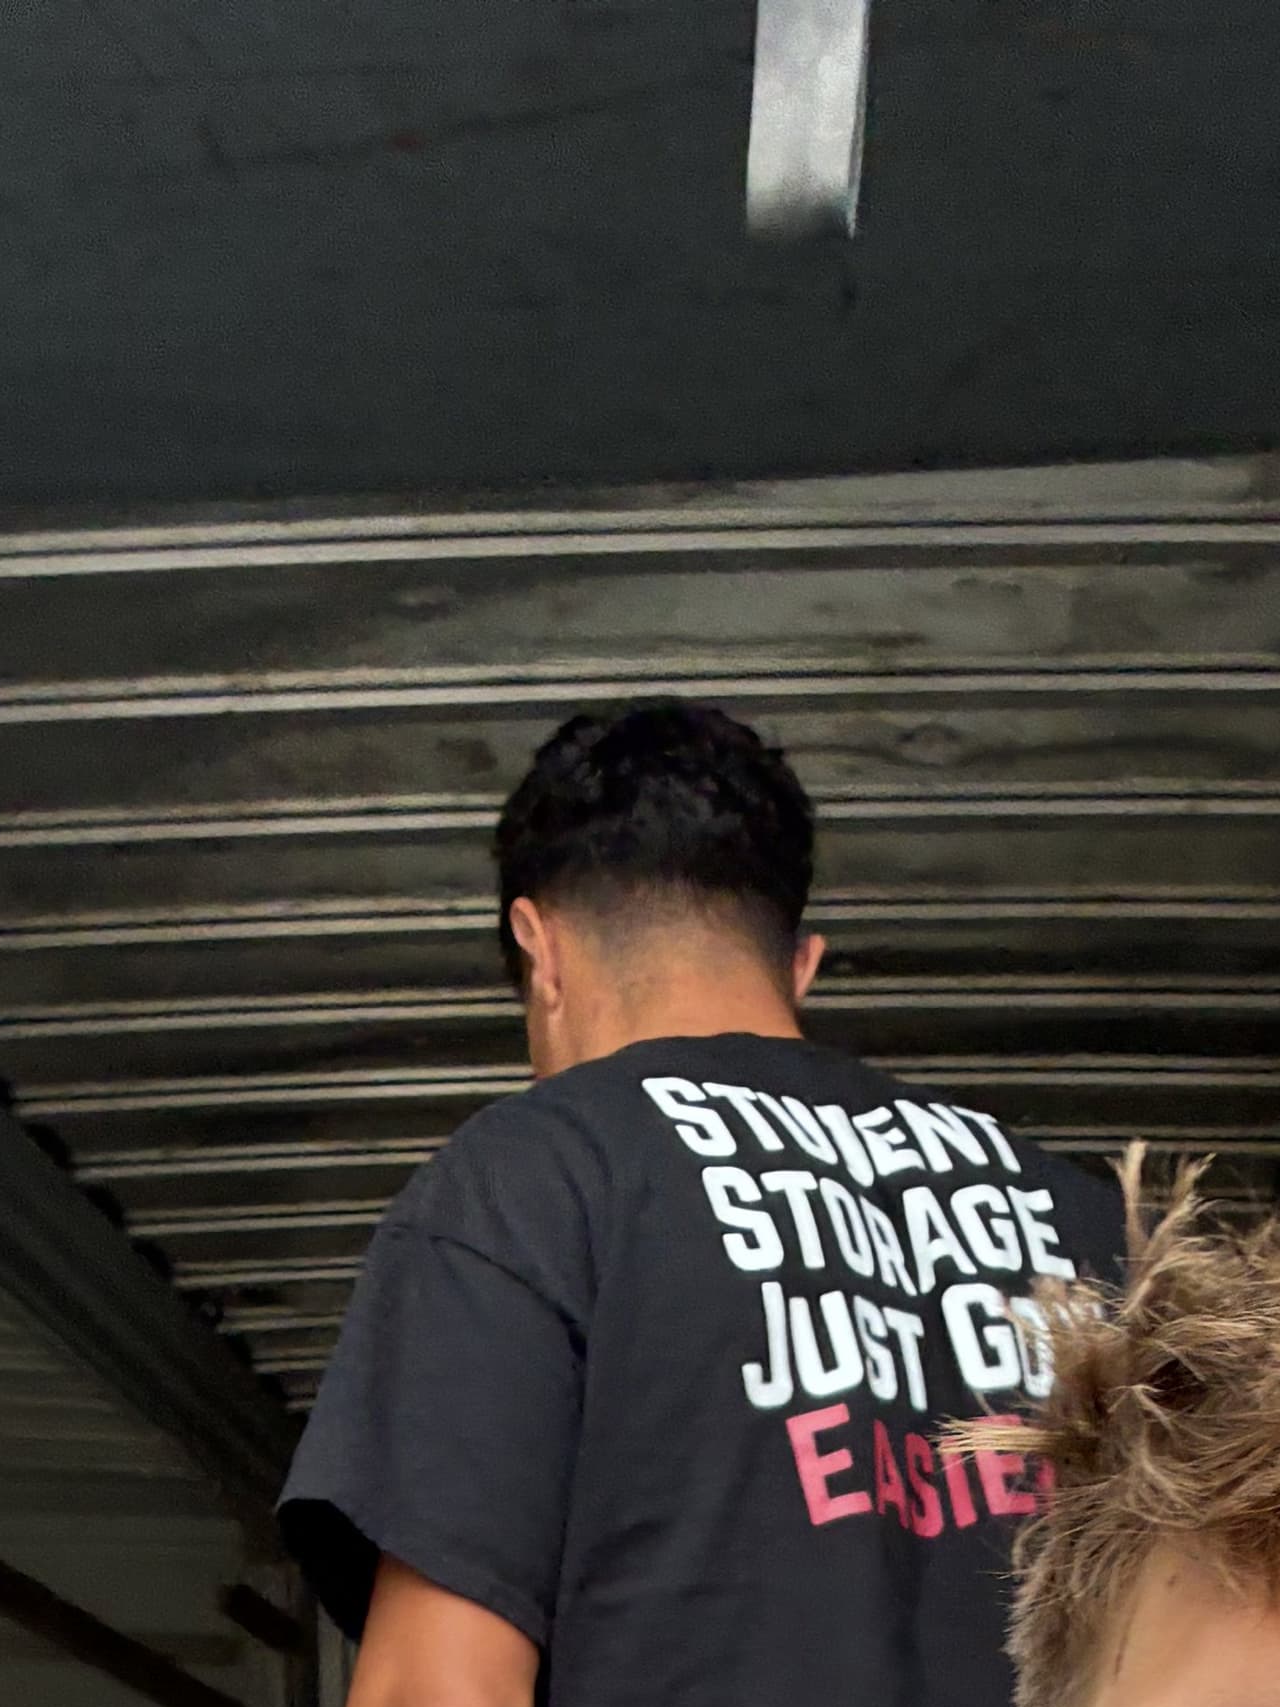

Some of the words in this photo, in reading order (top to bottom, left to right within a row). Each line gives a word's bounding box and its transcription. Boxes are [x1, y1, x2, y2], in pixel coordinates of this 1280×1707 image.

[701, 1165, 1077, 1297] STORAGE
[740, 1280, 929, 1413] JUST
[941, 1282, 1106, 1398] GO
[785, 1402, 1057, 1538] EASIE
